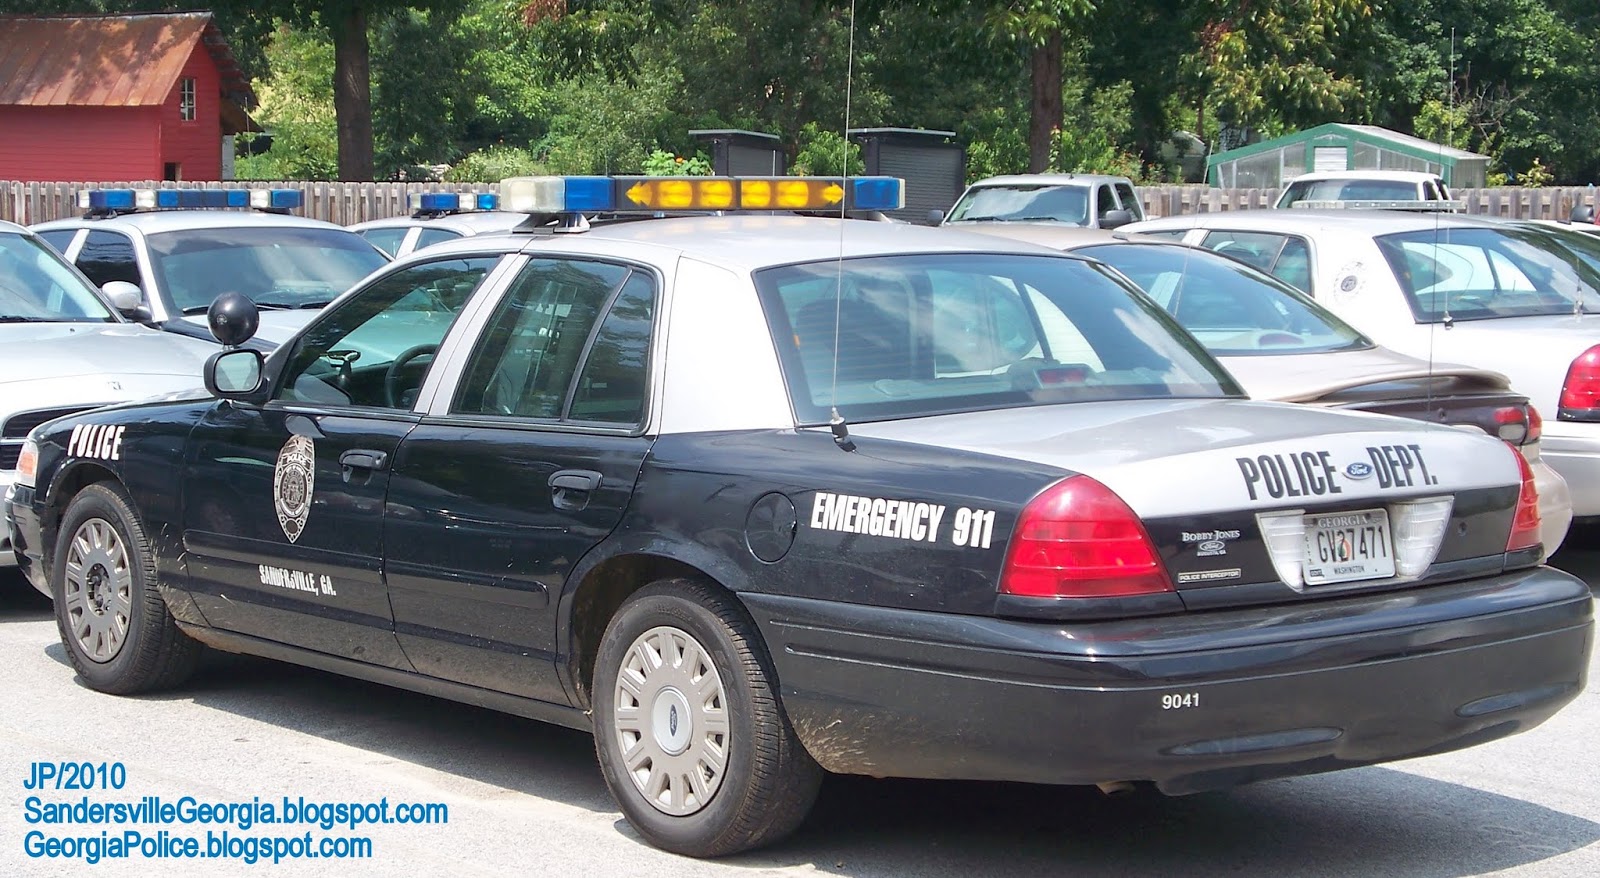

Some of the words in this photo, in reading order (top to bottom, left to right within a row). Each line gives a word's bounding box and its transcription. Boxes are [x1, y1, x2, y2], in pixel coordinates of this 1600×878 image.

[67, 423, 126, 461] POLICE
[1236, 450, 1342, 500] POLICE
[1366, 444, 1439, 489] DEPT.
[810, 492, 946, 543] EMERGENCY
[952, 507, 996, 549] 911
[1317, 514, 1369, 529] GEORGIA
[1181, 532, 1213, 542] BOBBY
[1213, 530, 1240, 541] JONES
[1317, 525, 1387, 563] GV27471
[320, 574, 337, 596] GA.
[1180, 573, 1200, 581] POLICE
[1201, 571, 1240, 579] INTERCEPTOR
[1162, 692, 1200, 710] 9041
